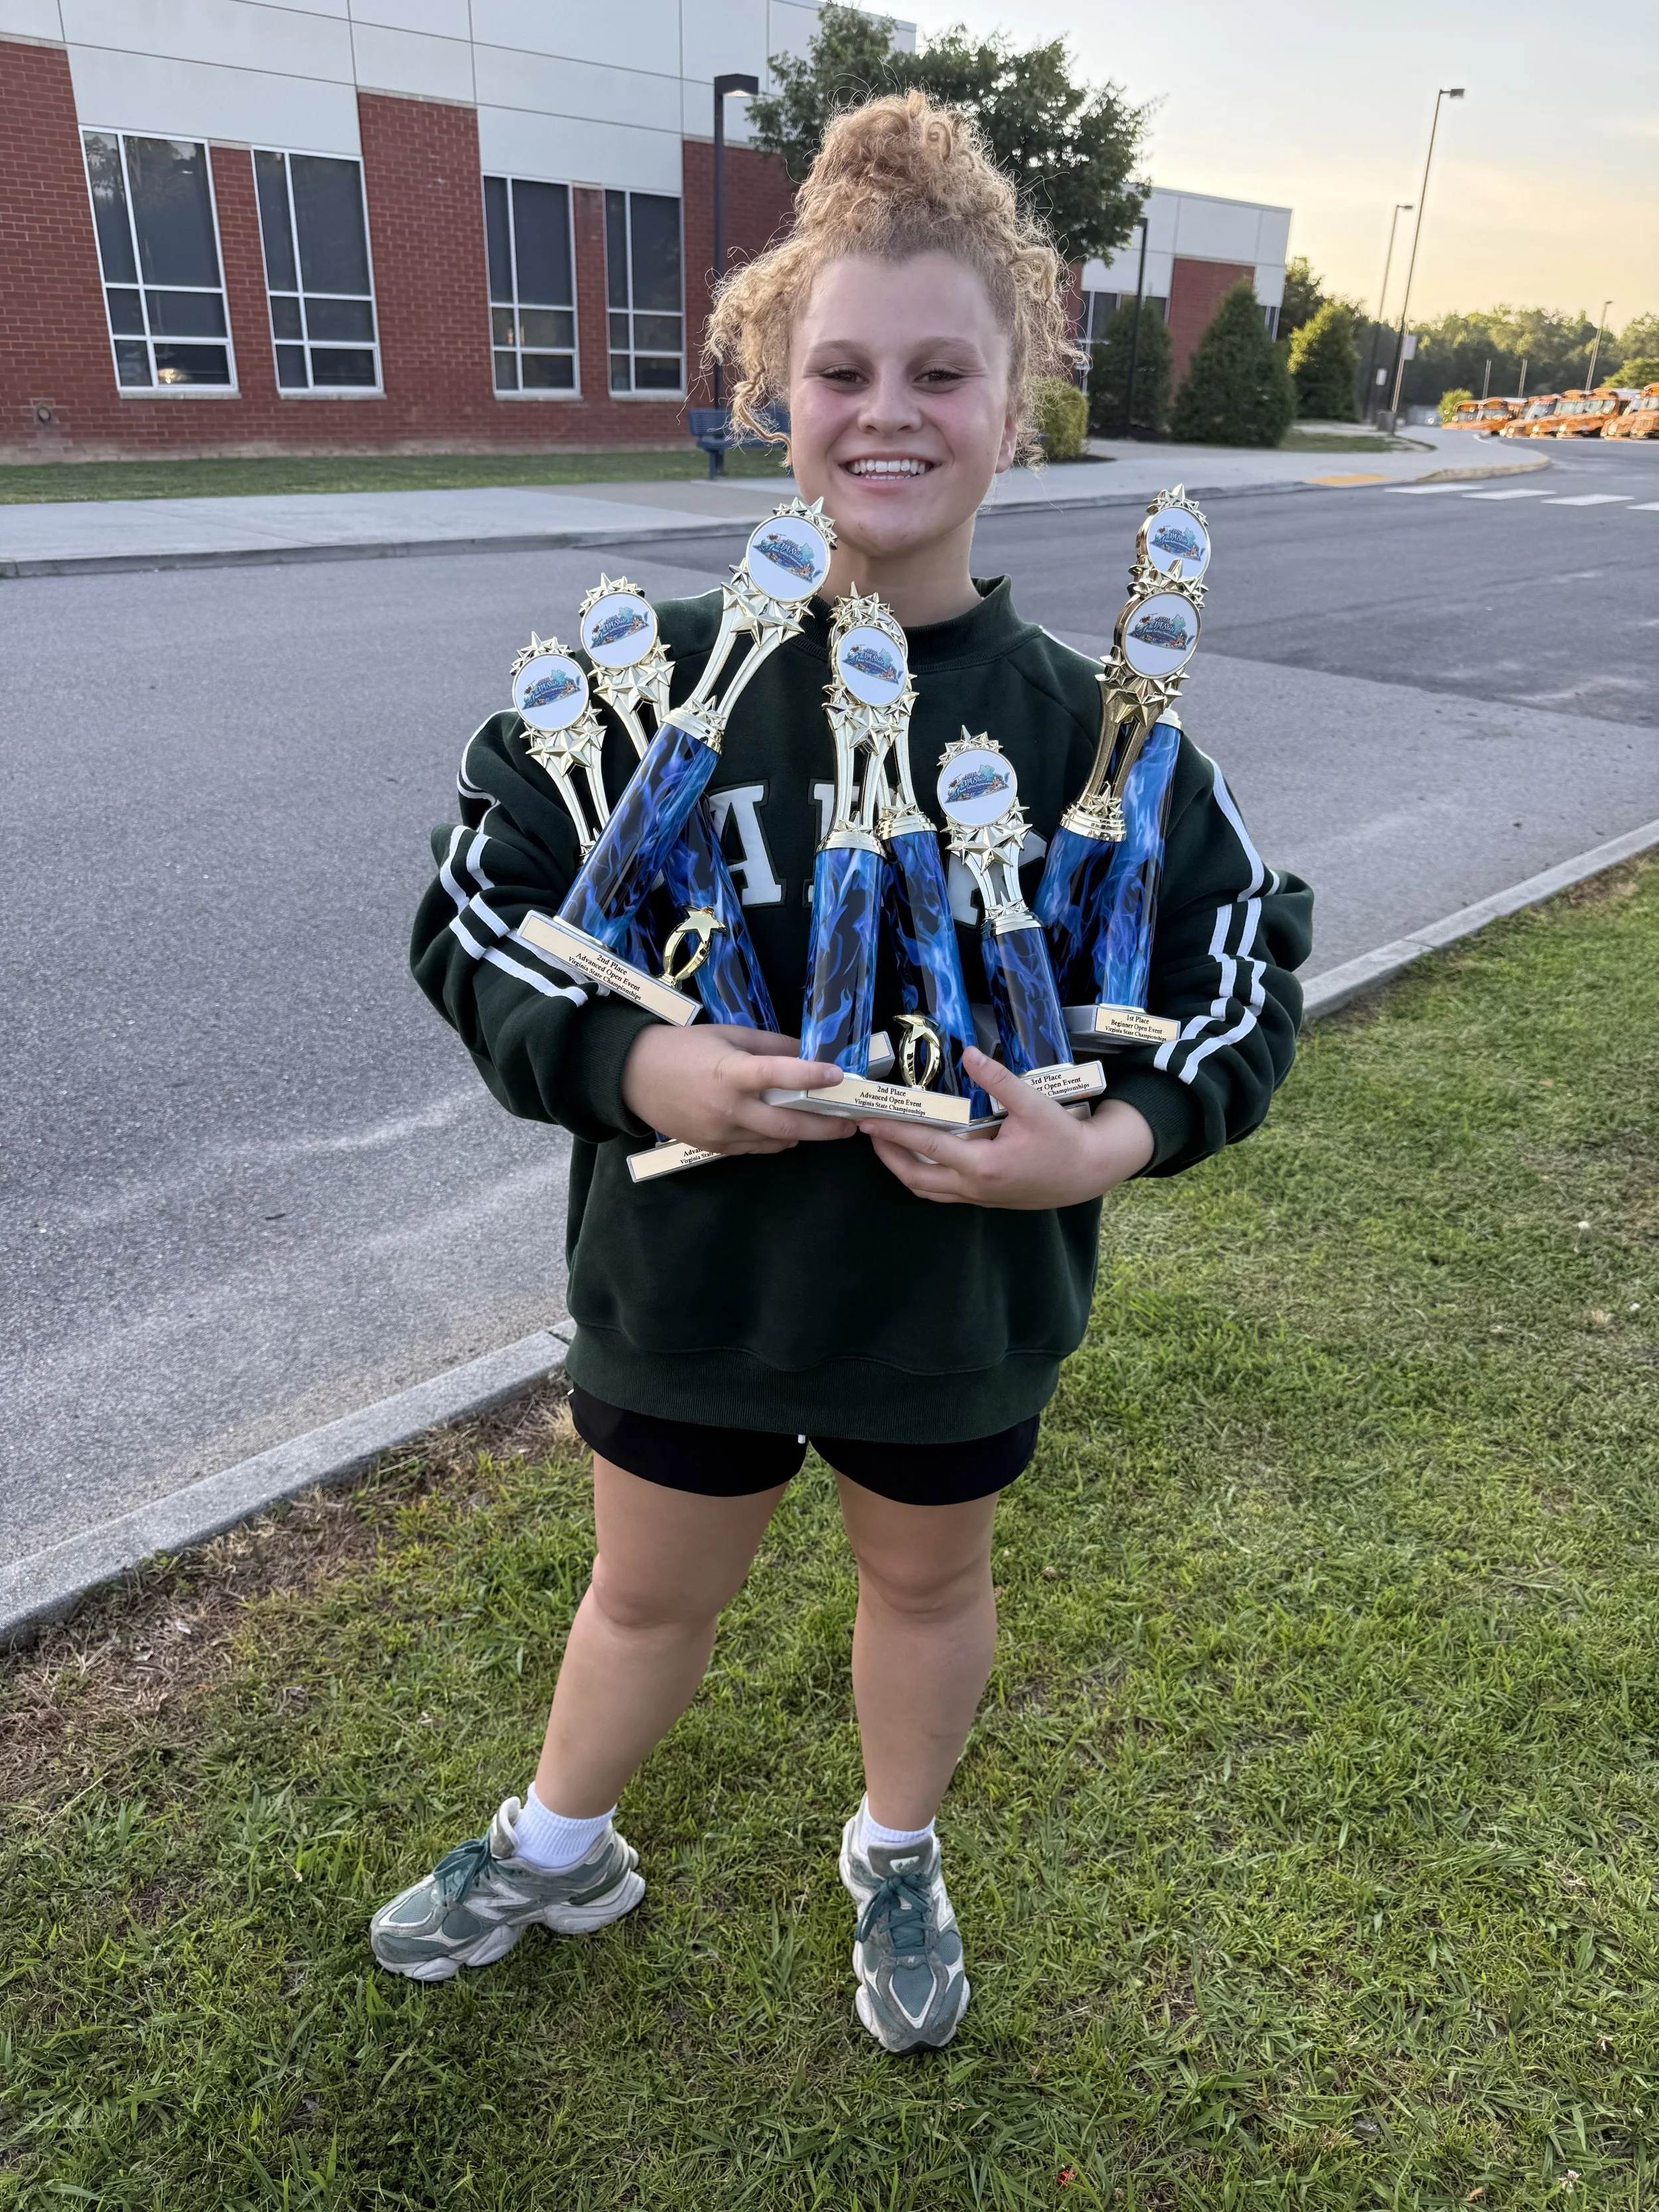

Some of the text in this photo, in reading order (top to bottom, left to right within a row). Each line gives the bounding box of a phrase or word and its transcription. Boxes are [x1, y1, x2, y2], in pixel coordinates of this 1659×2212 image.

[597, 954, 628, 976] 2nd Place
[569, 956, 642, 1001] Virginia State Championships
[576, 953, 641, 992] Advanced Open Event
[1111, 1019, 1133, 1029] Beginner
[1148, 1026, 1163, 1035] Event
[1135, 1016, 1149, 1025] Place
[1105, 1025, 1122, 1034] Virginia
[1134, 1031, 1167, 1043] Championships
[1031, 1074, 1062, 1086] 3rd Place
[1062, 1077, 1082, 1086] Event
[890, 1088, 906, 1096] Place
[1047, 1082, 1090, 1096] Championships
[859, 1091, 922, 1108] Advanced Open Event
[889, 1104, 926, 1116] Championships
[680, 1155, 701, 1164] Virginia
